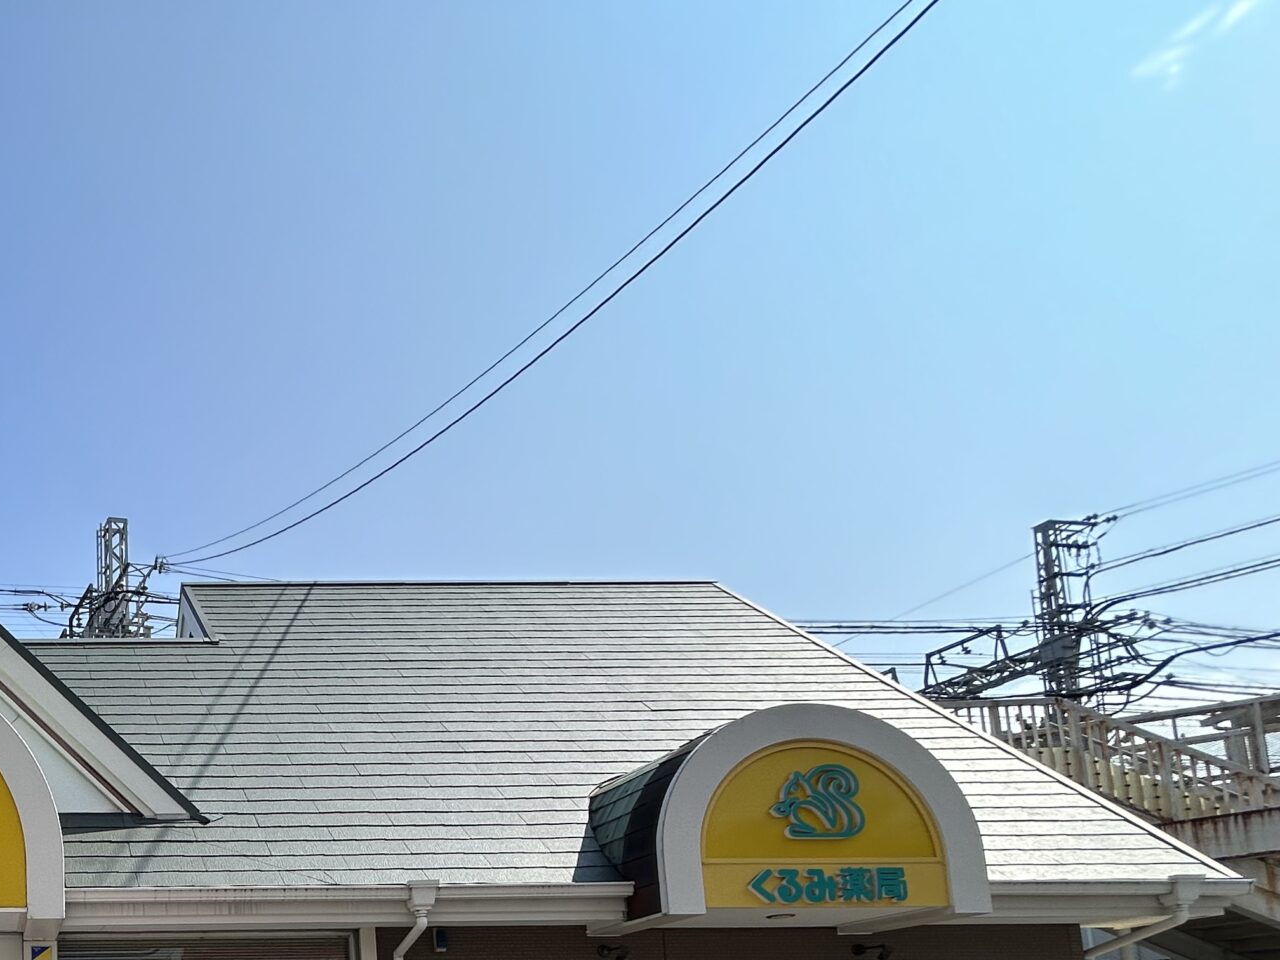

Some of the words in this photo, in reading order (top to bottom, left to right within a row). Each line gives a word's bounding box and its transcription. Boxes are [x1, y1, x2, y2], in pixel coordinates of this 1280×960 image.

[746, 866, 909, 903] くるみ薬局
